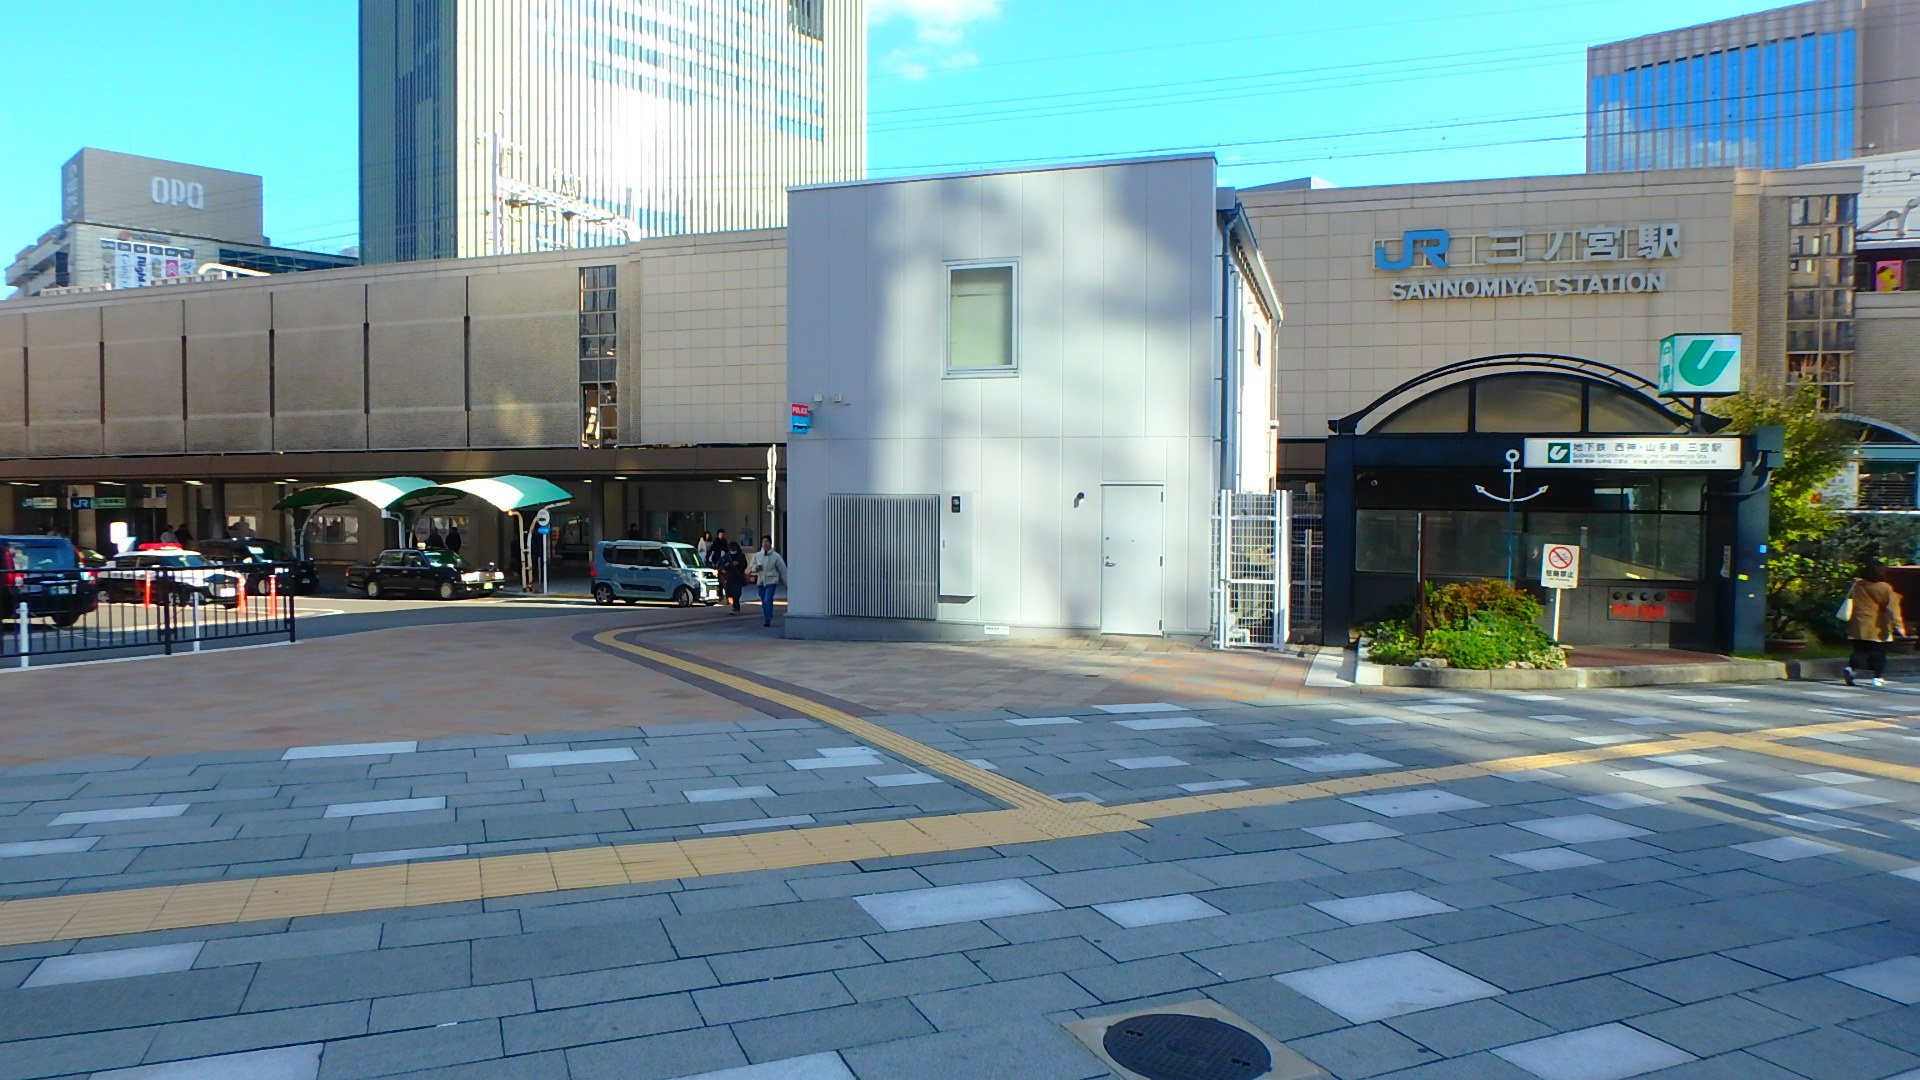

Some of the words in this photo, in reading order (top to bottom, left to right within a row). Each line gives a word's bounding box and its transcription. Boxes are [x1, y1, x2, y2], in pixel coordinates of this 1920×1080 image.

[1375, 229, 1451, 271] JR
[1486, 223, 1681, 264] 三ノ宮駅
[1390, 276, 1539, 302] SANNOMIYA
[1554, 272, 1667, 297] STATION
[792, 407, 808, 415] POLICE
[1573, 443, 1606, 452] 地下鉄
[1687, 443, 1722, 453] 三宮駅
[72, 499, 89, 508] JR
